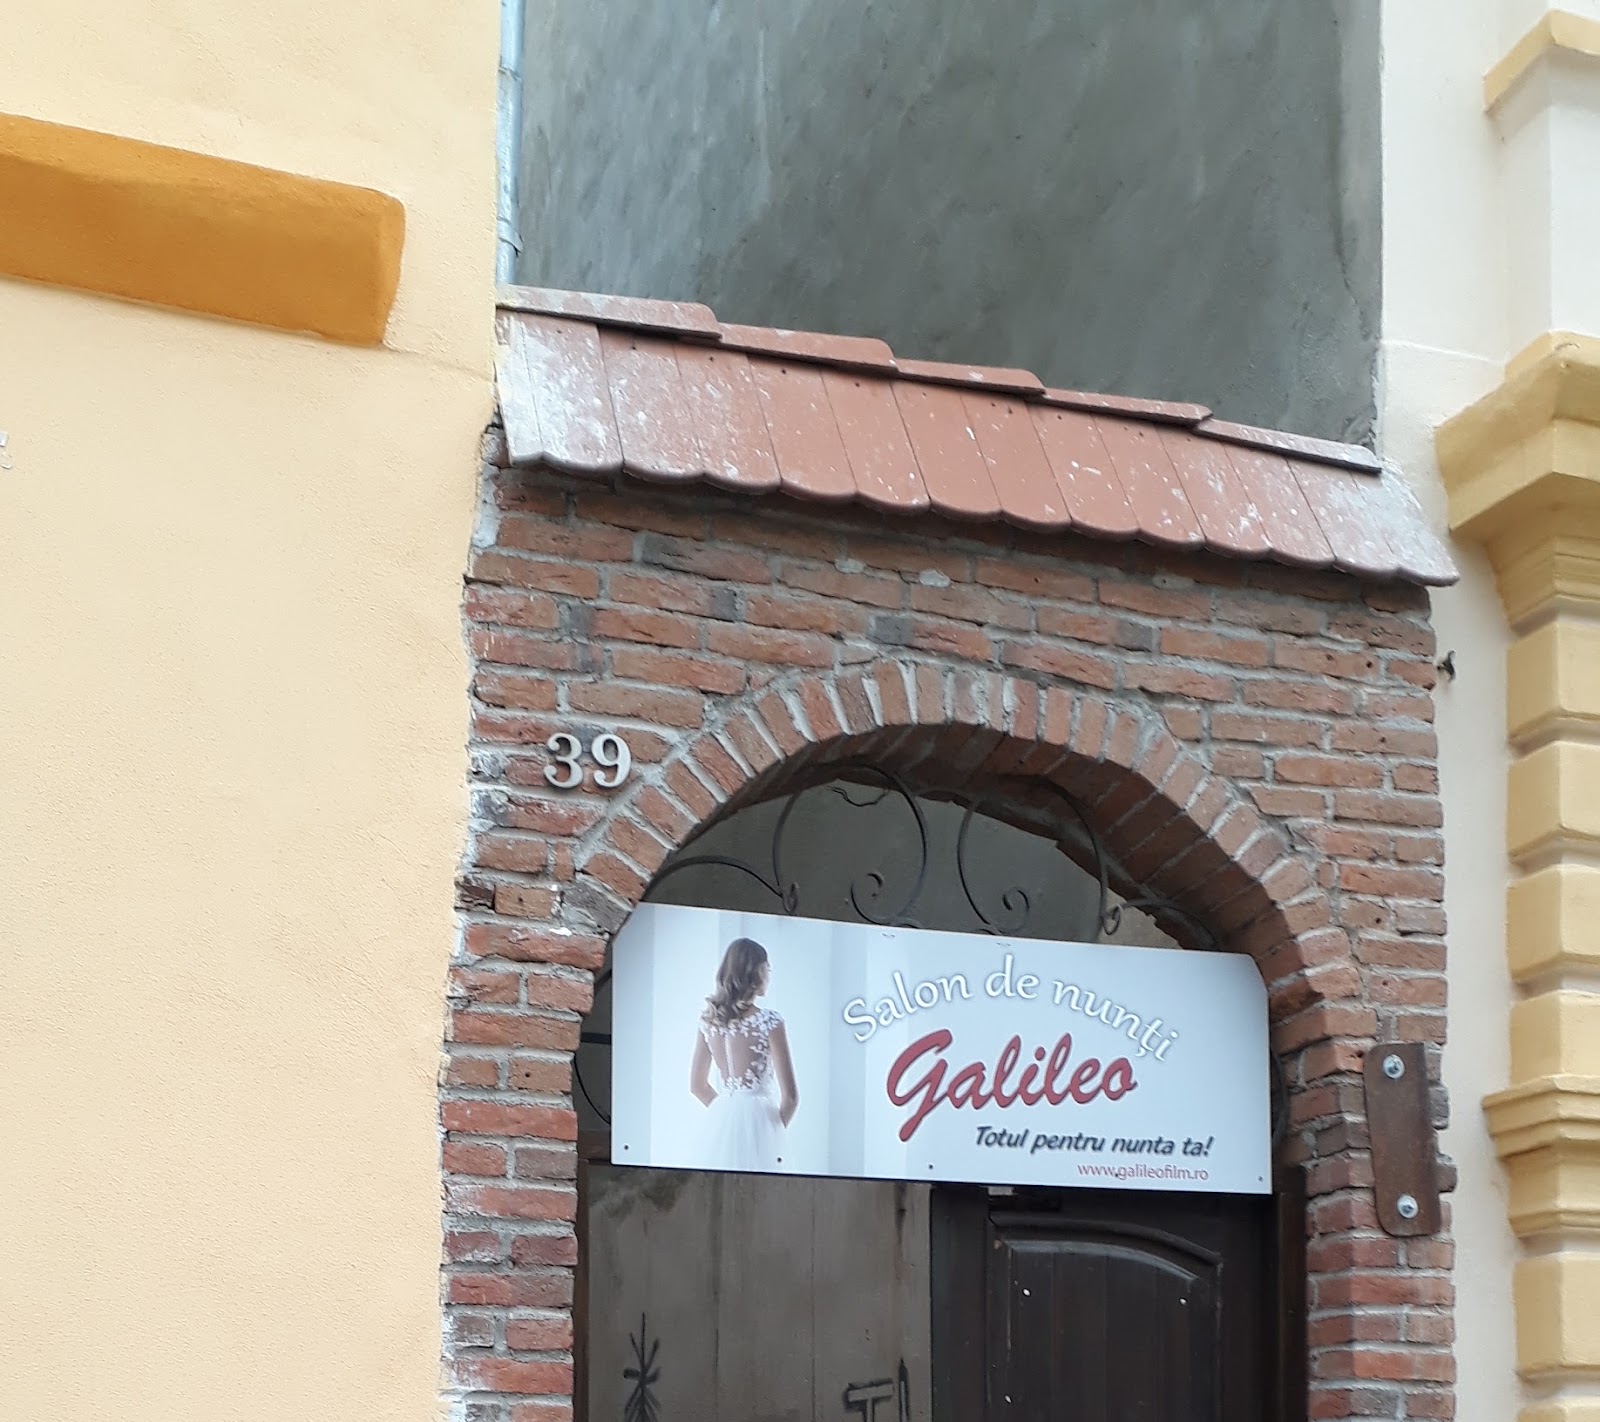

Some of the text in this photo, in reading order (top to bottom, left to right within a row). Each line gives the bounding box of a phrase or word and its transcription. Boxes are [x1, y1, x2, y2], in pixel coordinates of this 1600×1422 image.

[543, 732, 632, 789] 39
[842, 953, 1181, 1062] Salon de nunți
[886, 1028, 1139, 1143] Galileo
[975, 1125, 1215, 1158] Totul pentru nunta ta!
[1076, 1162, 1210, 1182] www.galileofilm.ro
